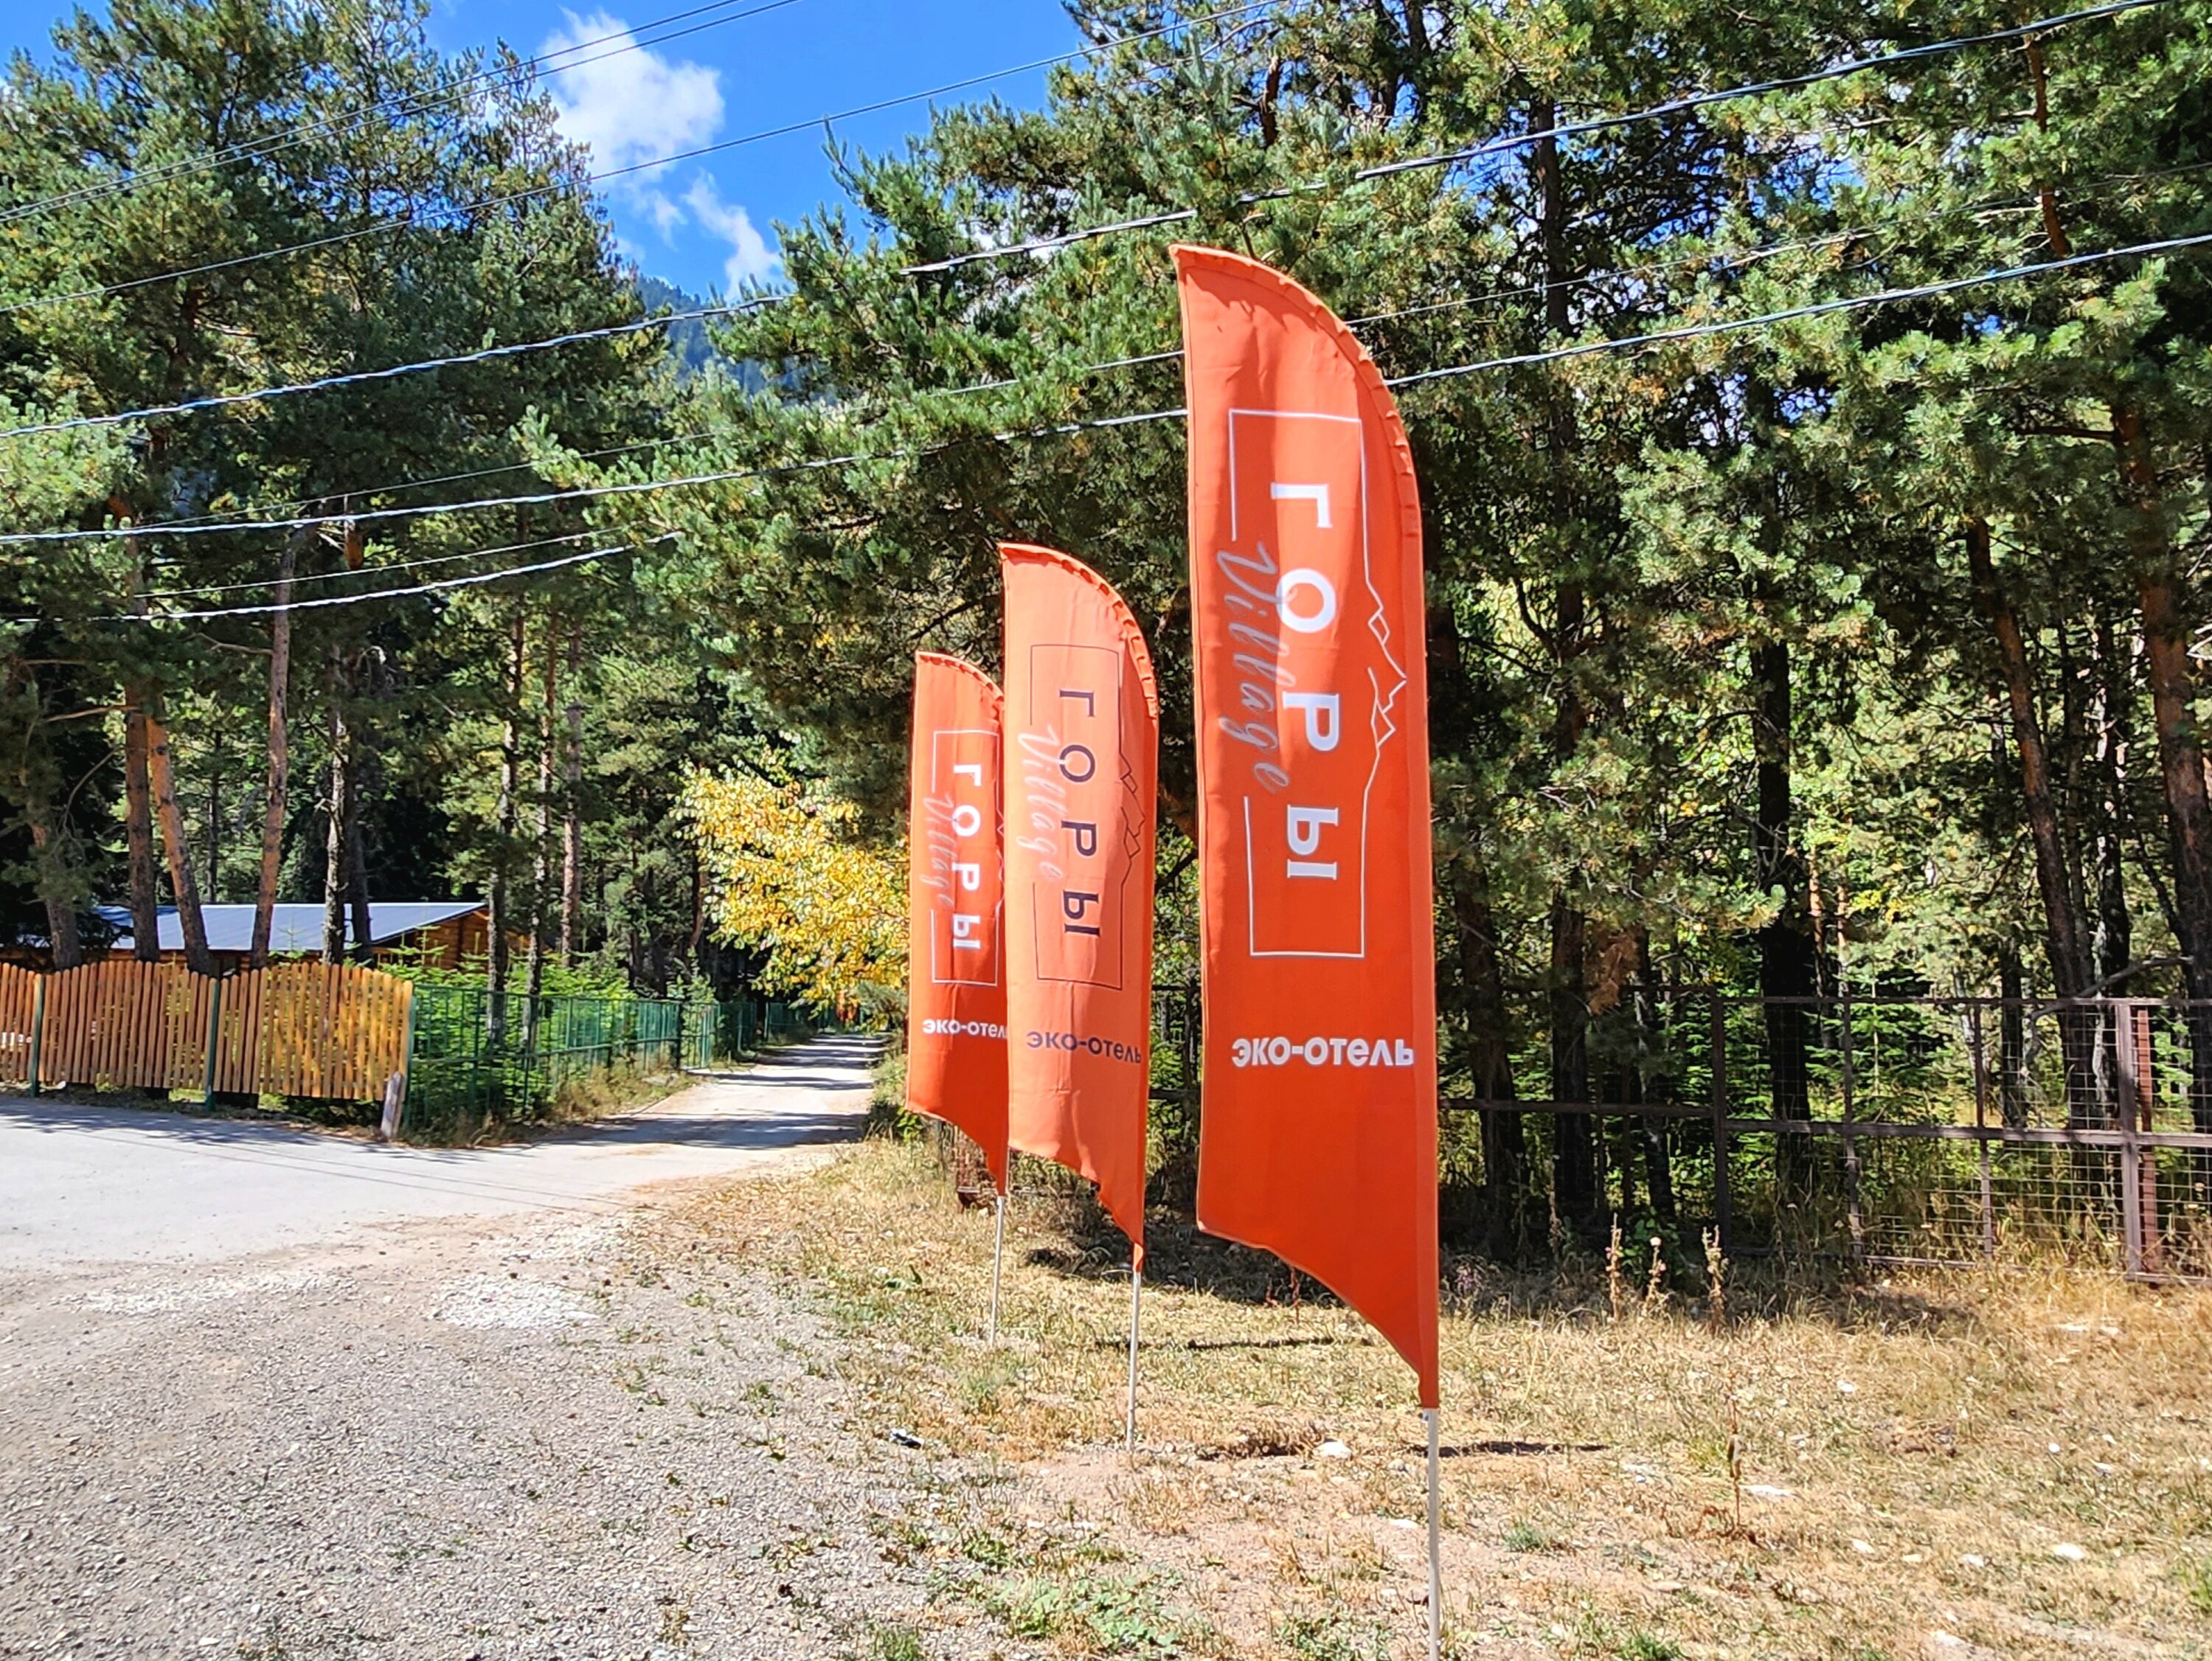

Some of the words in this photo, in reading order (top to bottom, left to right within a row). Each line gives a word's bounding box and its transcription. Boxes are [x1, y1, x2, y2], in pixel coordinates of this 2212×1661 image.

[1216, 540, 1297, 794] Village
[1270, 482, 1339, 880] ГОРЫ
[951, 764, 982, 950] ГОРЫ
[1016, 724, 1069, 879] Village
[1058, 690, 1101, 937] ГОРЫ
